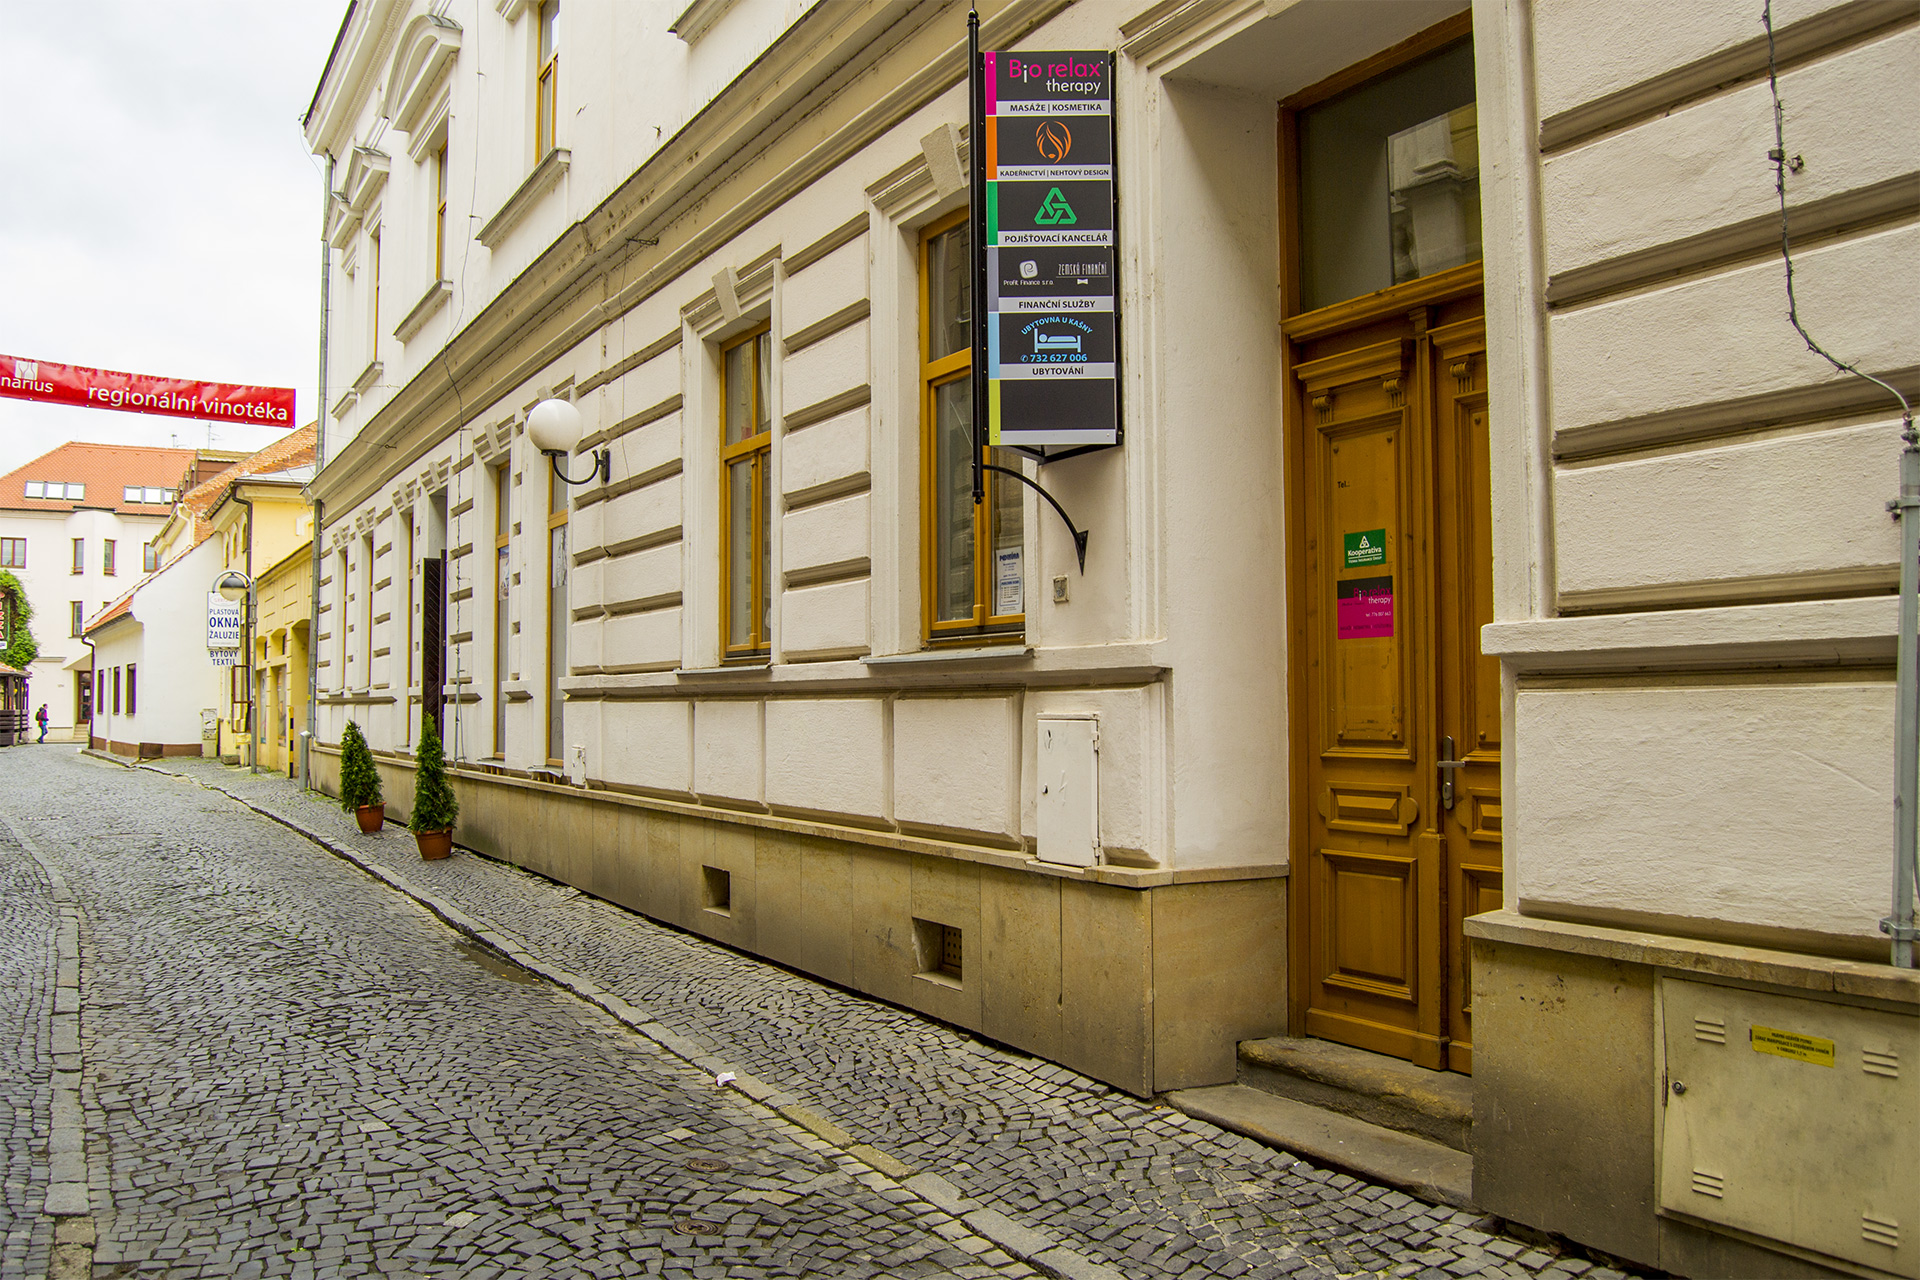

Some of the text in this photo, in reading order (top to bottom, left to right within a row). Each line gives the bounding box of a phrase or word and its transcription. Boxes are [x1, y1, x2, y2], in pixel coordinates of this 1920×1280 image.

[1009, 57, 1101, 83] Bio relax
[1046, 78, 1101, 95] therapy
[1010, 103, 1102, 112] MASÁŽE KOSMETIKA
[1050, 168, 1082, 176] NEHTOVÝ
[1004, 232, 1108, 243] POJIŠŤOVACÍ KANCELÁŘ
[1058, 261, 1080, 276] ZEMSKÁ
[1018, 300, 1096, 309] FINANČNÍ SLUŽBY
[1021, 316, 1060, 335] UBYTOVNA
[1068, 318, 1093, 334] KAŠNY
[1030, 353, 1088, 362] 732 627 006
[1032, 365, 1084, 375] UBYTOVÁNÍ
[88, 386, 288, 421] regionální vinotéka
[1348, 546, 1382, 557] Kooperativa
[1353, 584, 1391, 601] Bio relax
[1368, 596, 1391, 605] therapy
[209, 616, 239, 628] OKNA
